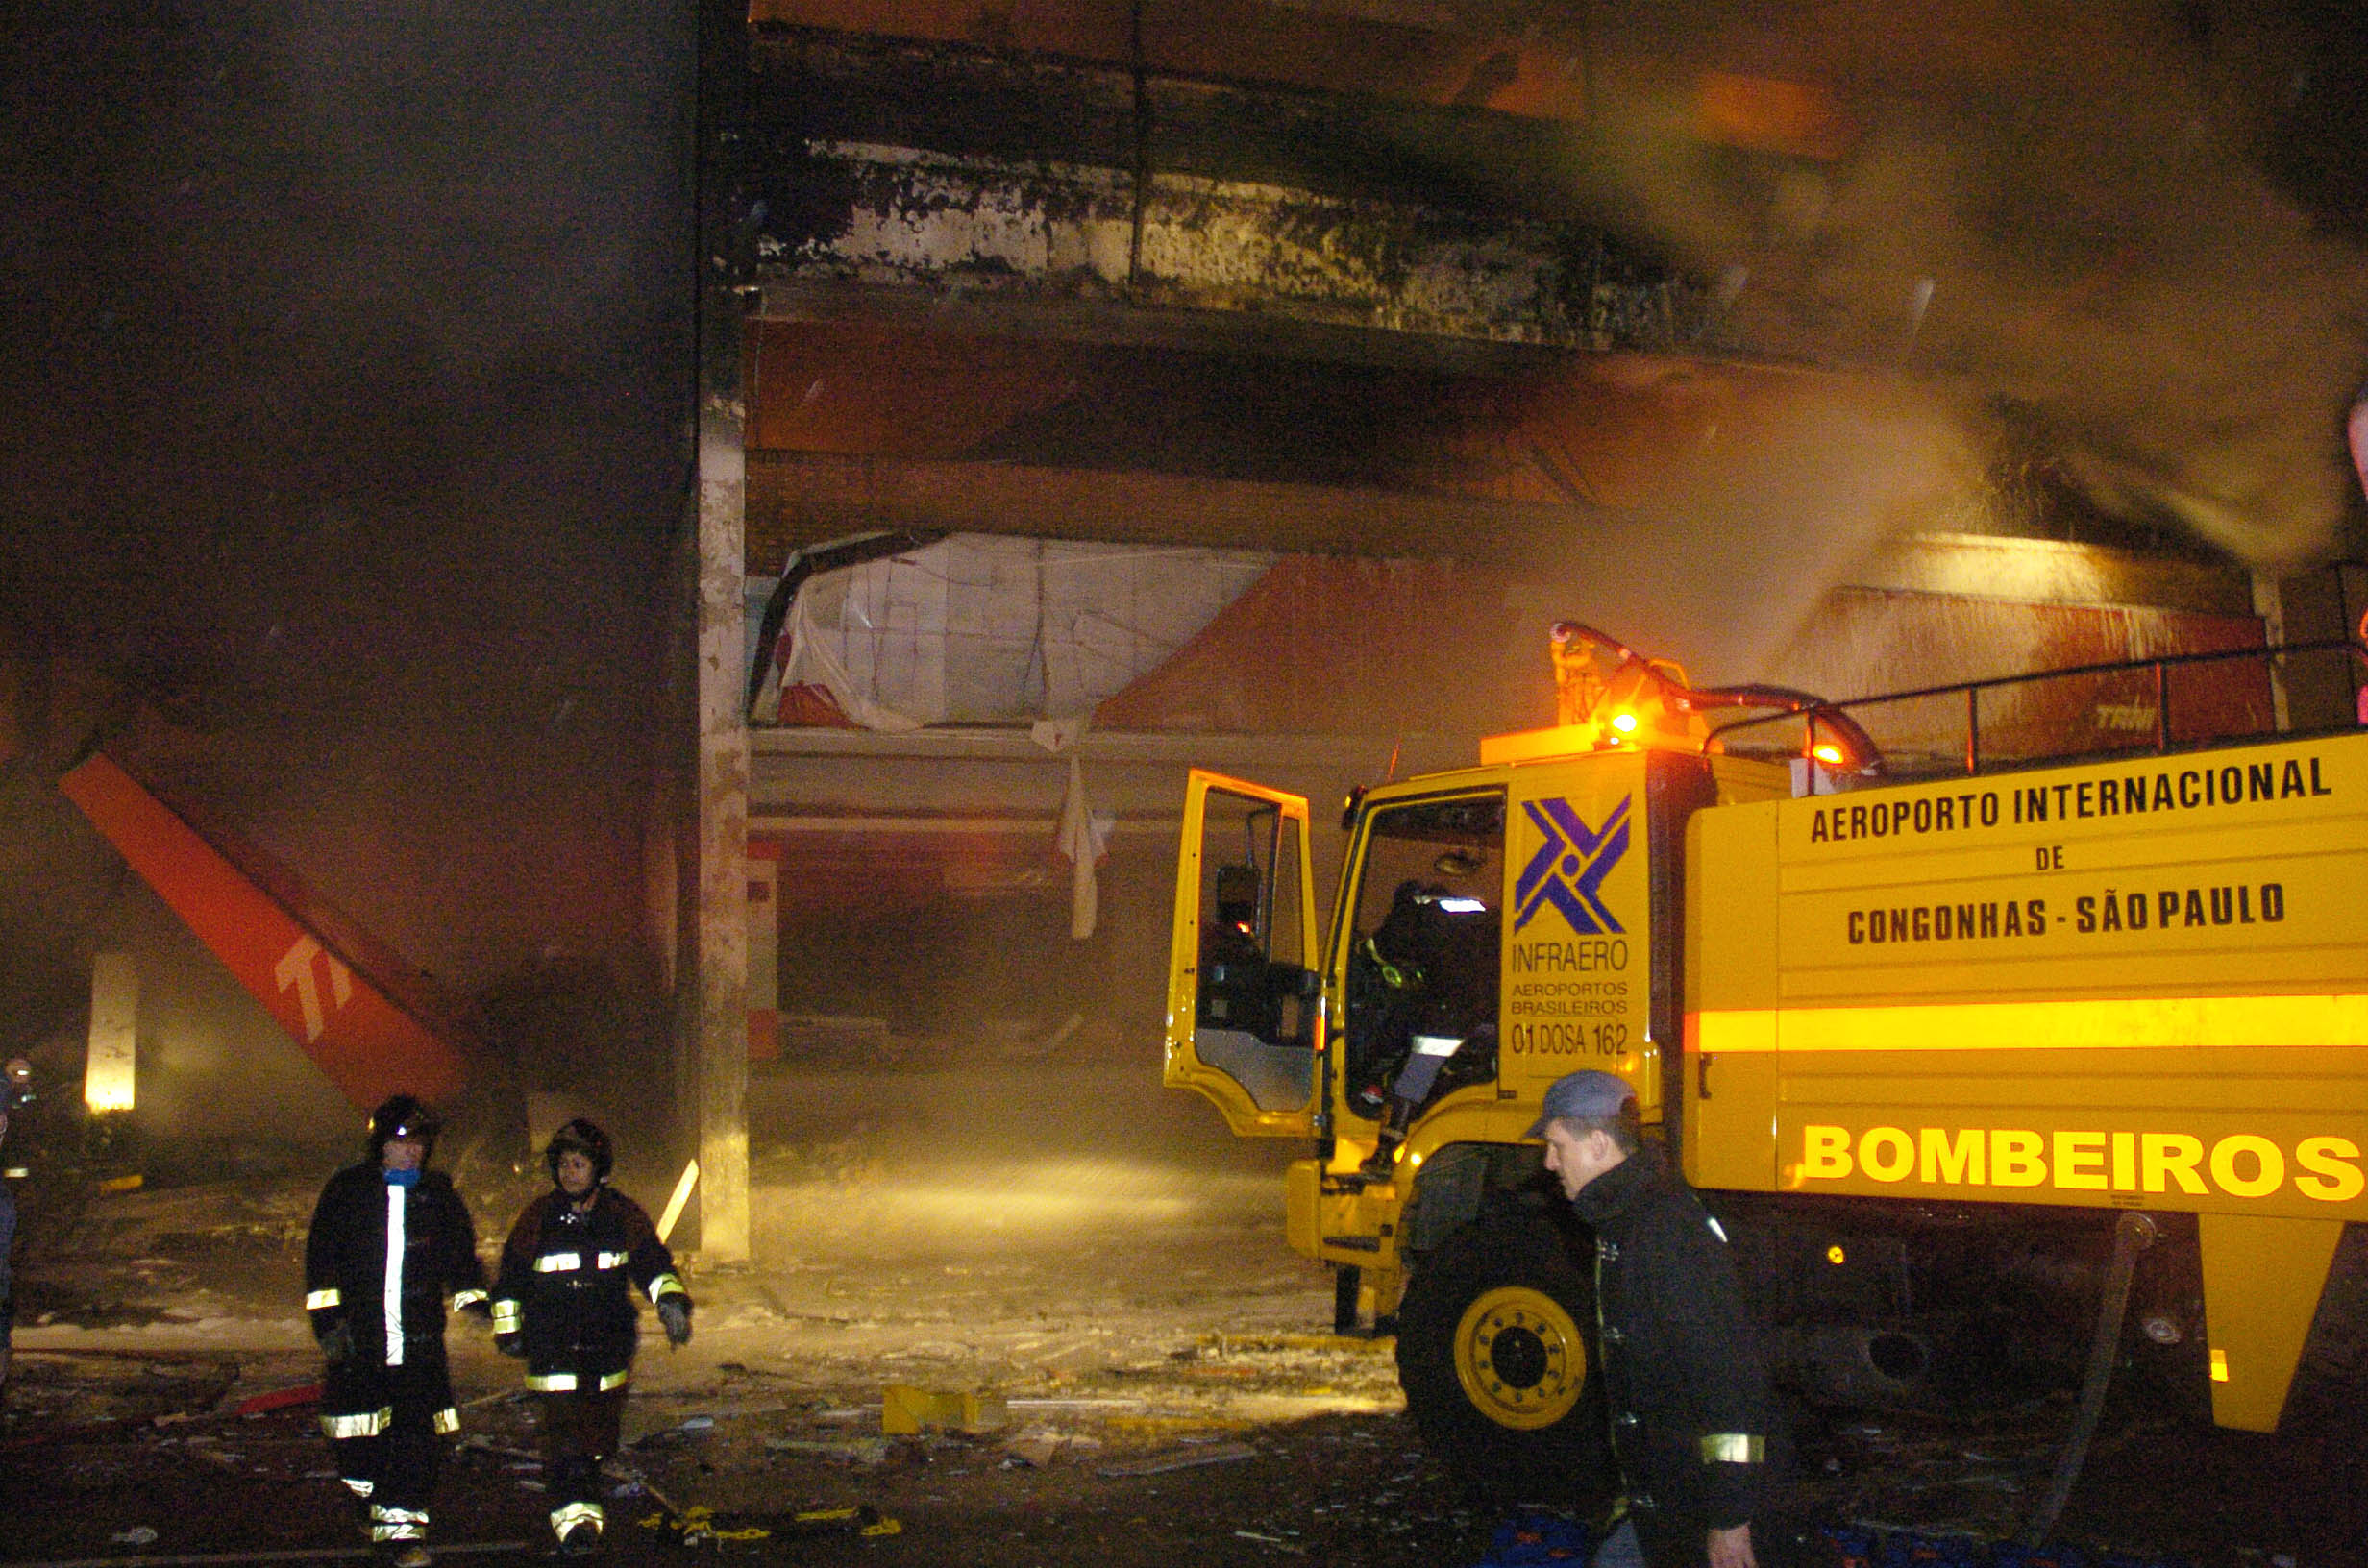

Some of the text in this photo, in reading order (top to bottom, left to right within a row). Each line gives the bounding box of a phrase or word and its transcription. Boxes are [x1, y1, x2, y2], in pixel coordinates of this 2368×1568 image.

[1811, 757, 2332, 843] AEROPORTO INTERNACIONAL
[2035, 845, 2064, 871] DE
[1847, 899, 2047, 945] CONGONHAS
[2076, 888, 2148, 933] SÃO
[2158, 883, 2284, 929] PAULO
[1512, 939, 1628, 973] INFRAERO
[1513, 981, 1628, 997] AEROPORTOS
[1511, 999, 1628, 1016] BRASILEIROS
[1512, 1023, 1628, 1055] 01 DOSA 162
[1803, 1124, 2366, 1202] BOMBEIROS
